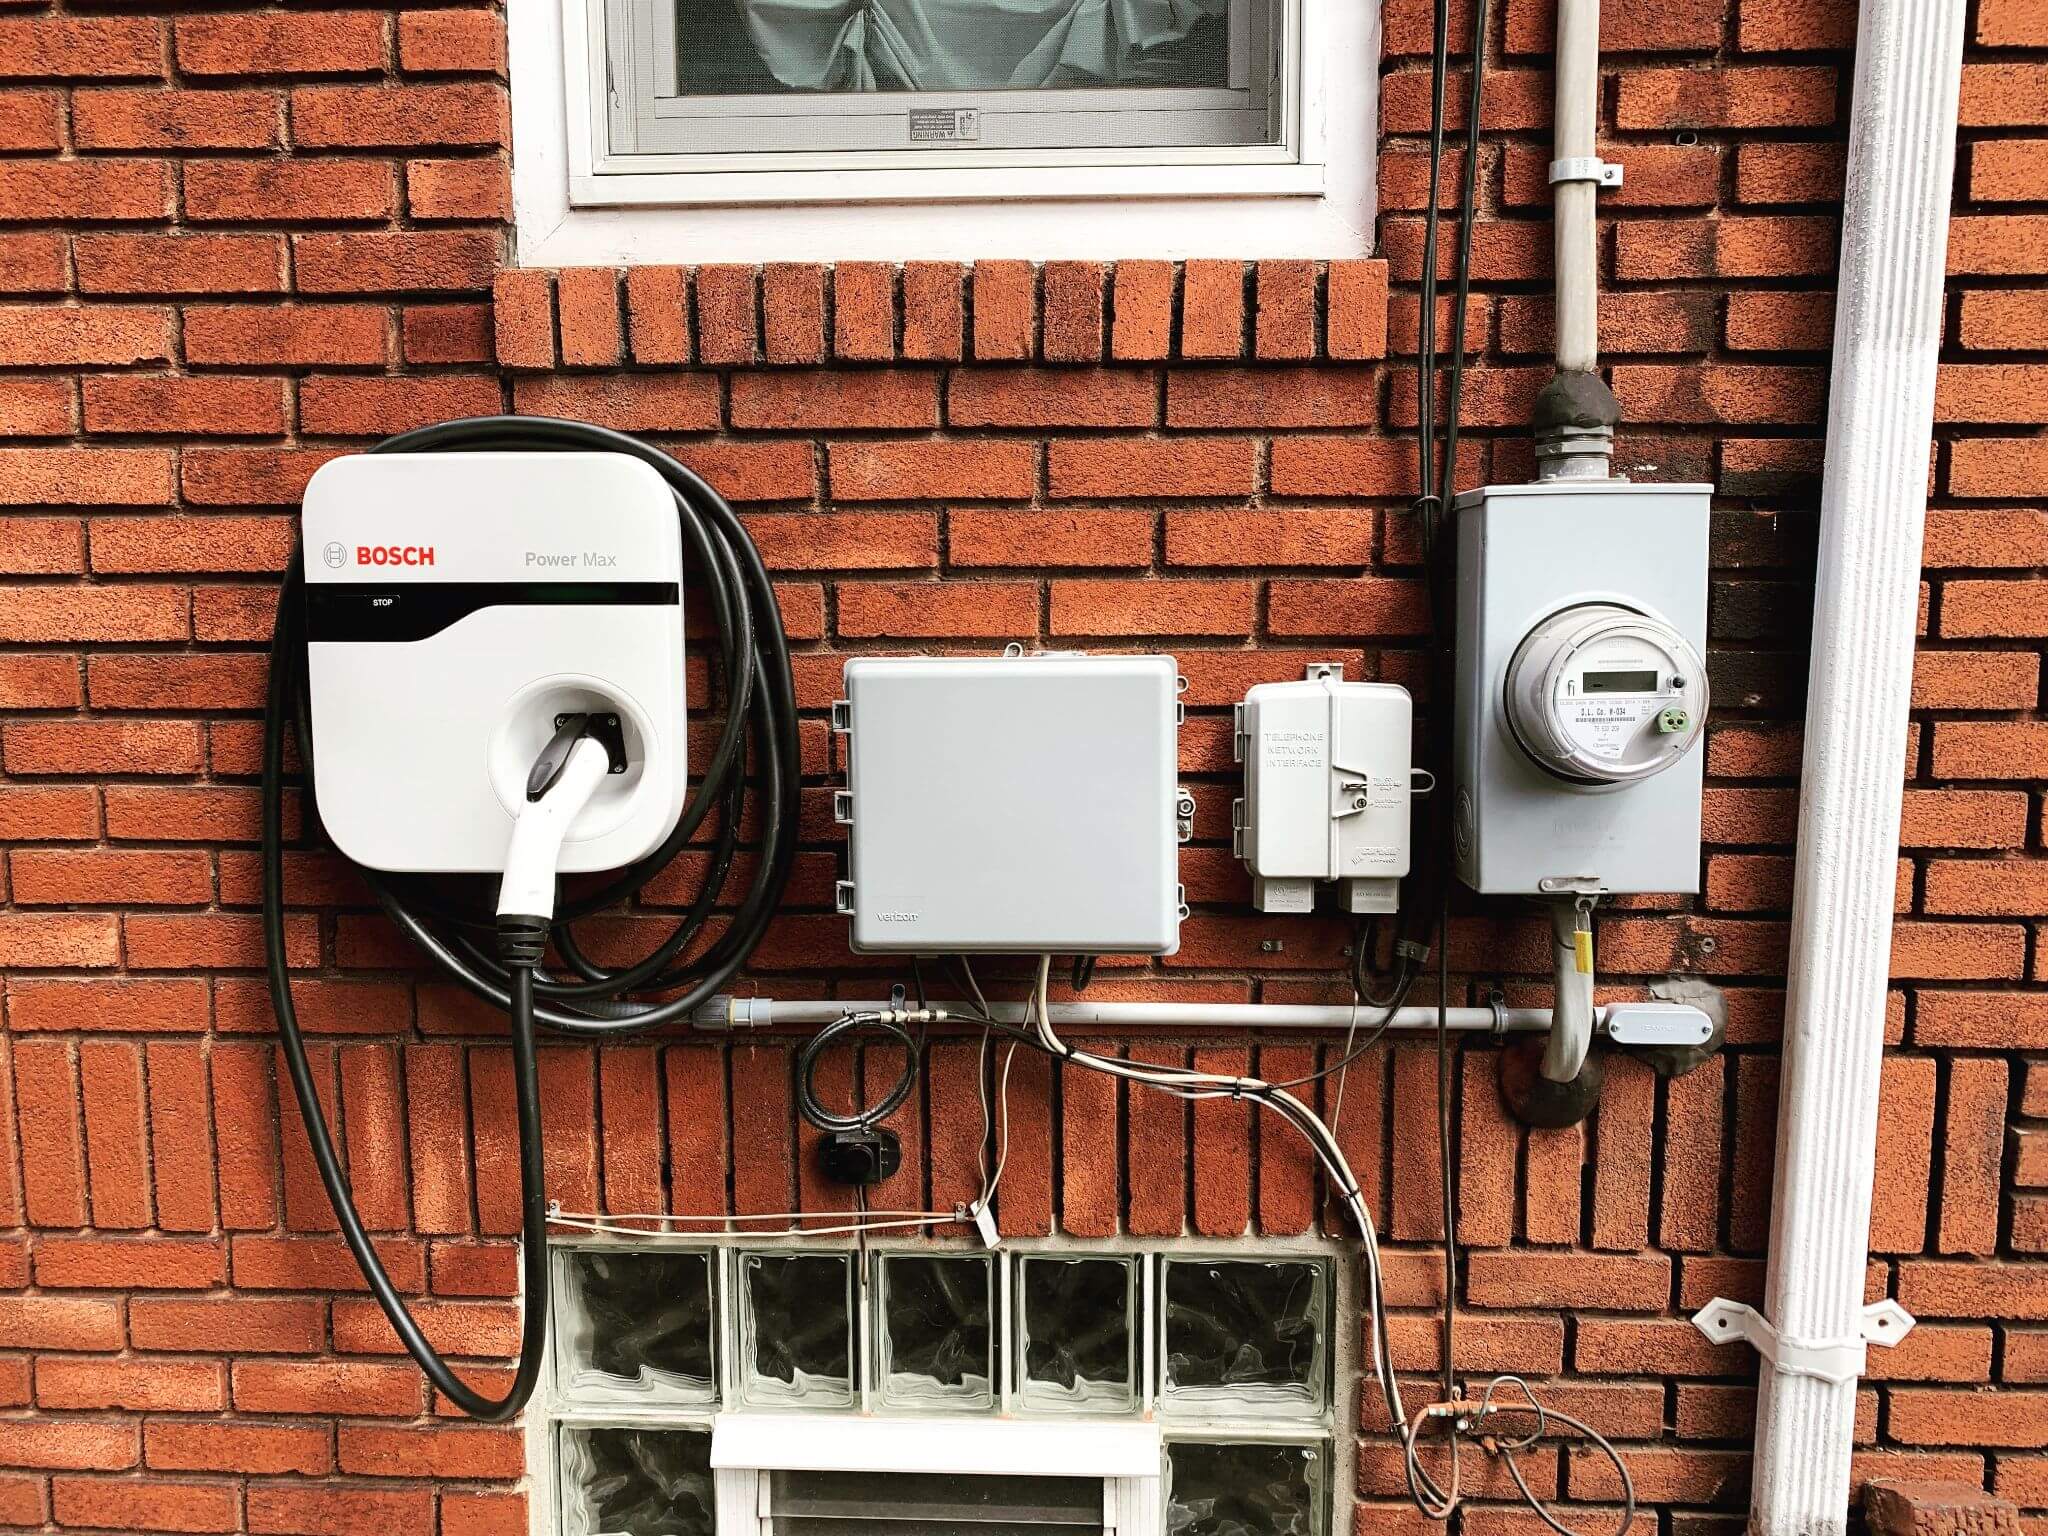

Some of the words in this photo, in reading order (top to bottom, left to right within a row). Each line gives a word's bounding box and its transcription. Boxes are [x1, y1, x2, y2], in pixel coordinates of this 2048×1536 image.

[912, 130, 946, 139] WARNING
[356, 546, 435, 566] BOSCH
[525, 552, 577, 567] Power
[583, 552, 617, 567] Max
[373, 599, 393, 607] STOP
[1263, 733, 1324, 742] TELEPHONE
[1268, 746, 1319, 755] NETWORK
[1266, 759, 1322, 768] INTERFACE
[876, 911, 919, 922] verizon
